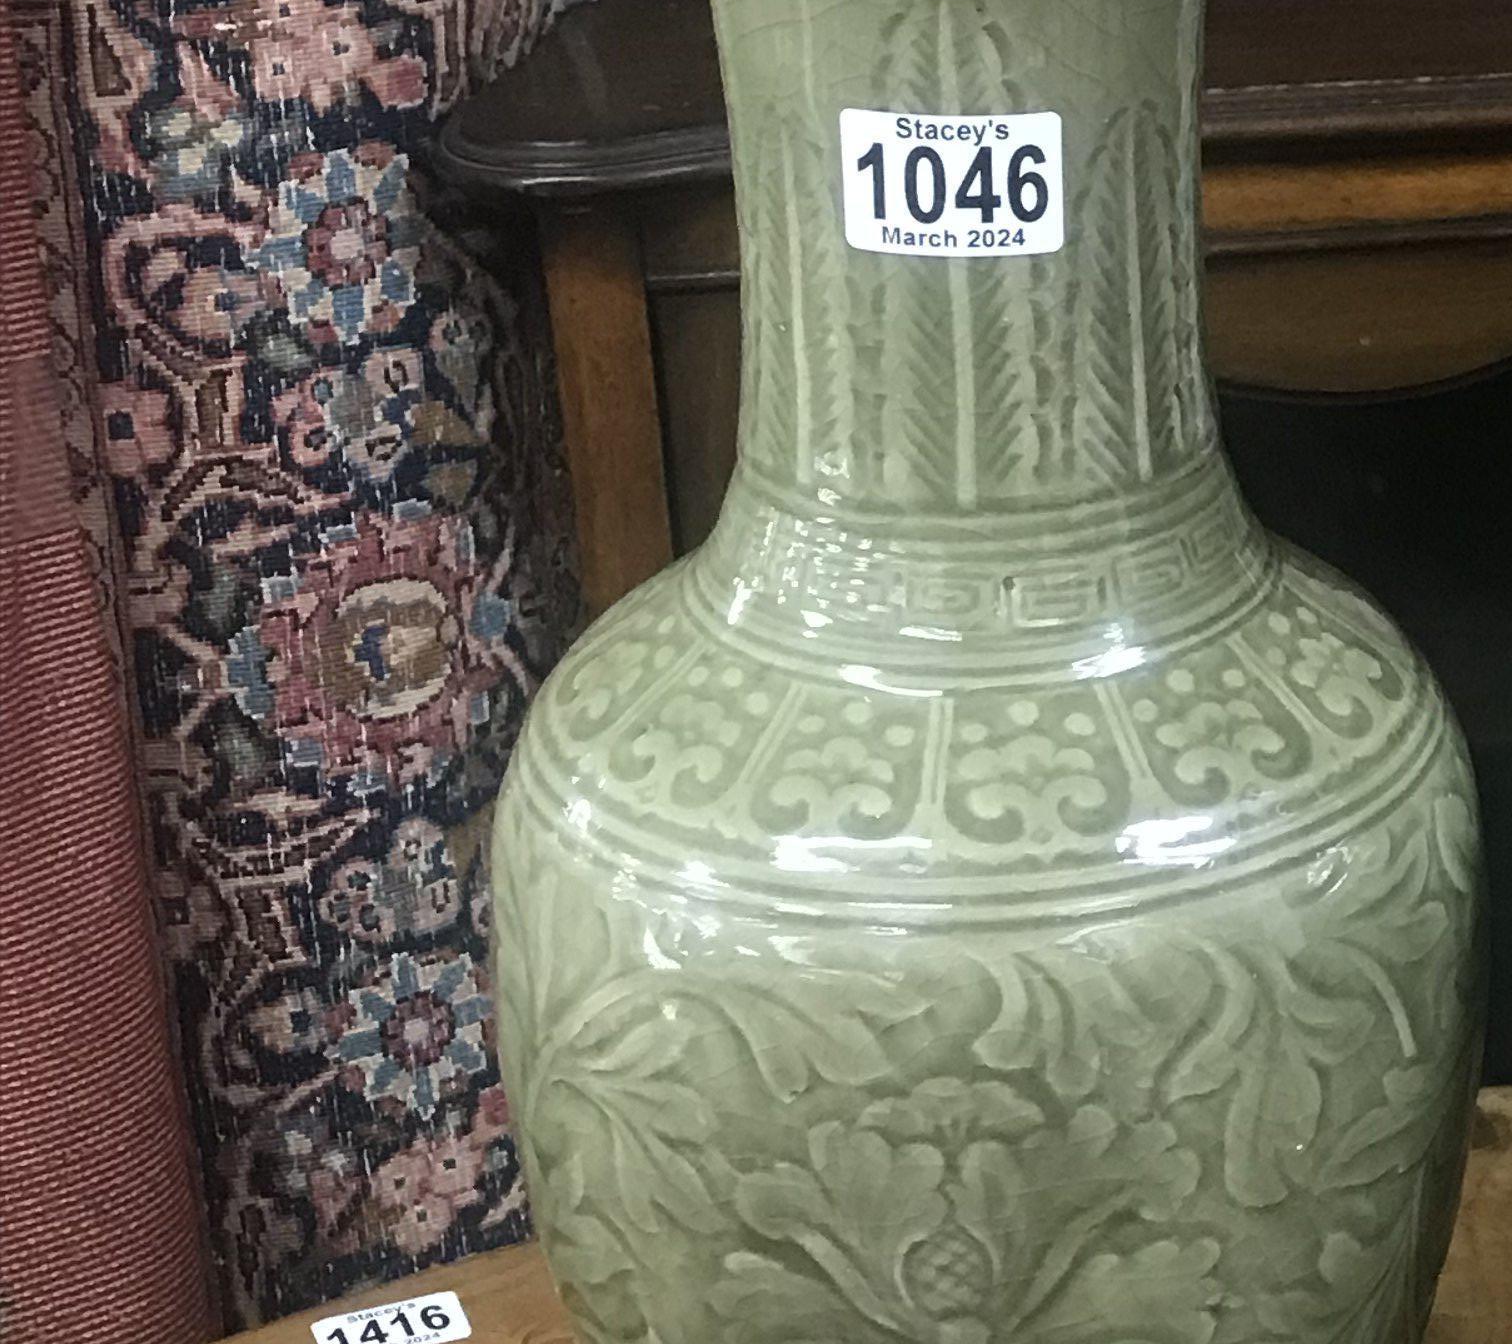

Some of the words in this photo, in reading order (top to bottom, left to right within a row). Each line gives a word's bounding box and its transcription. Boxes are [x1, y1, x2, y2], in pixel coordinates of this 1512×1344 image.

[896, 118, 1009, 146] Stacey's
[857, 142, 1049, 224] 1046
[882, 226, 957, 248] March
[967, 228, 1026, 248] 2024
[347, 1301, 416, 1323] Stacey's
[406, 1331, 441, 1344] 2024
